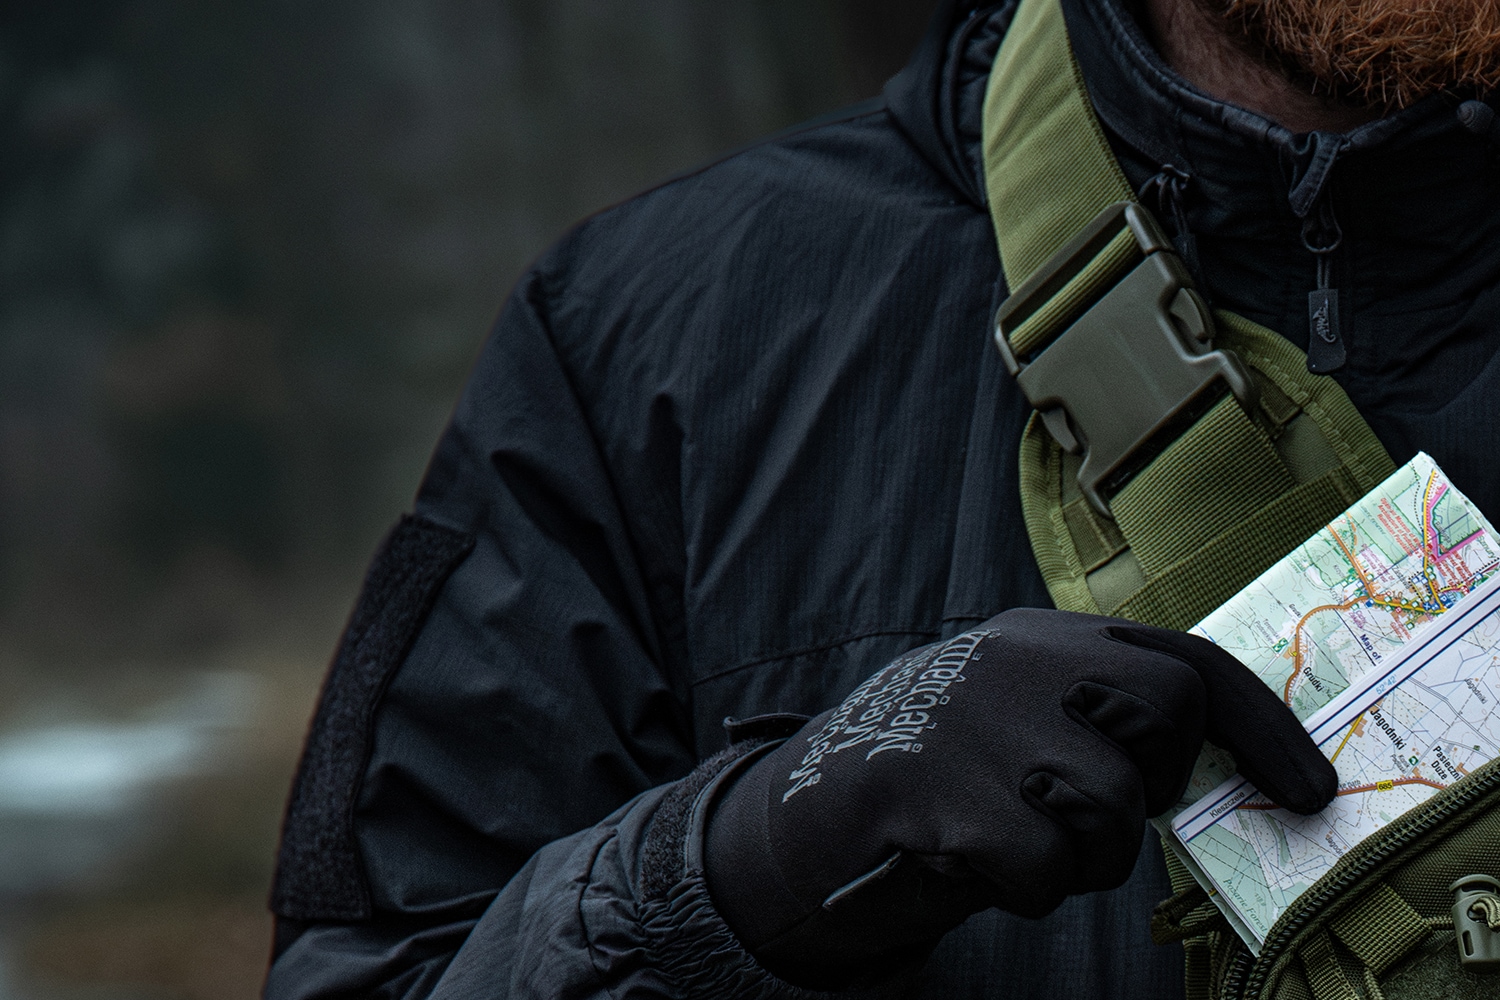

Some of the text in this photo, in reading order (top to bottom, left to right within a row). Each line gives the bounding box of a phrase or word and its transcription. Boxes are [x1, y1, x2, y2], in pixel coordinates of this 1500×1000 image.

[1359, 634, 1382, 661] Map of
[1303, 666, 1325, 692] Grudki
[1375, 674, 1400, 695] 52°42'
[1464, 677, 1488, 704] Jagodniki
[1370, 707, 1407, 751] Jagodniki
[1431, 761, 1449, 780] Duże
[1378, 782, 1393, 791] 685
[1209, 790, 1246, 819] Kleszczele
